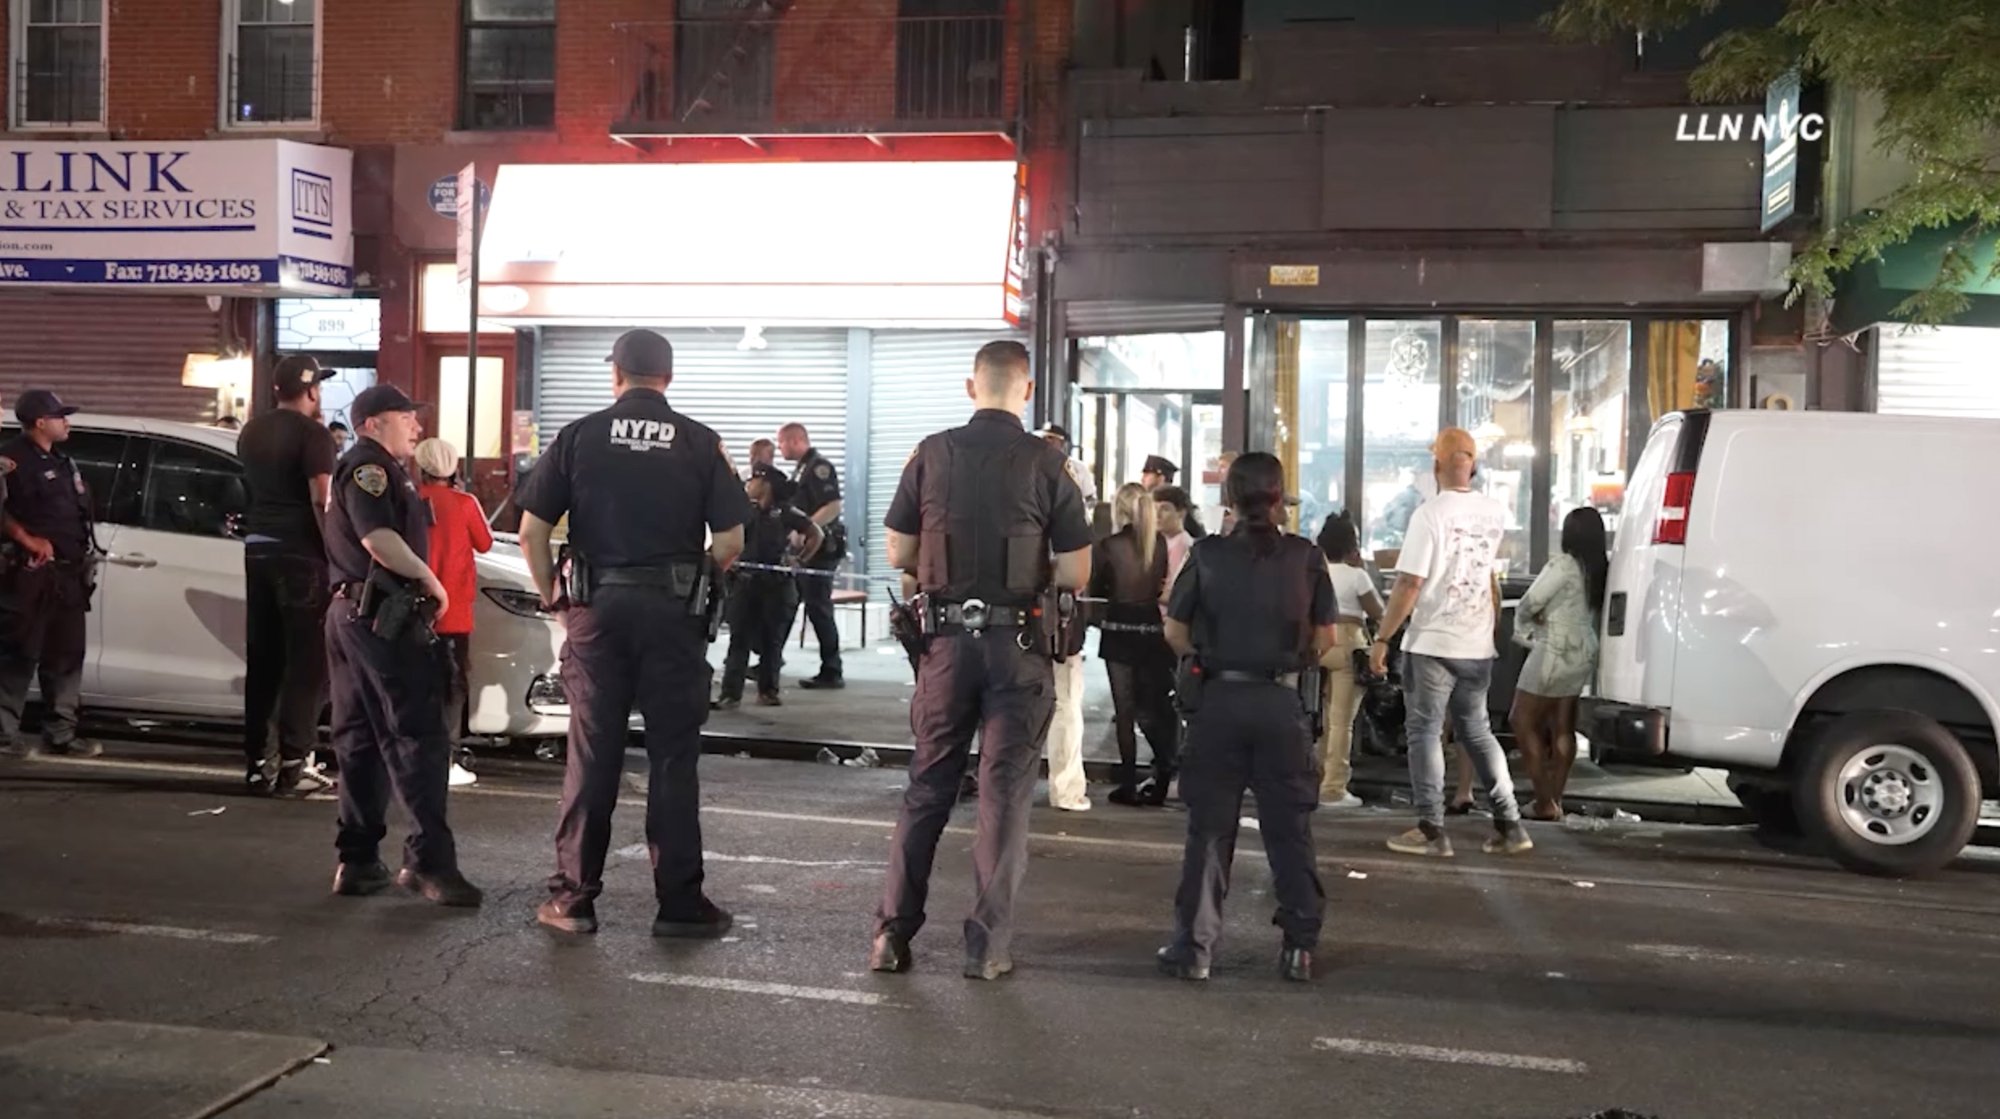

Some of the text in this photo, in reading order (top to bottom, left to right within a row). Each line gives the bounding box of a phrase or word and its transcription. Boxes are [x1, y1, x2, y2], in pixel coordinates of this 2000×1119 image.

[0, 151, 193, 193] LINK
[296, 178, 329, 217] ITTS
[434, 188, 456, 198] FOR
[4, 199, 256, 219] & TAX SERVICES
[105, 262, 143, 280] Fax:
[147, 263, 261, 282] 718-363-1603
[318, 319, 345, 332] 899
[610, 418, 675, 442] NYPD
